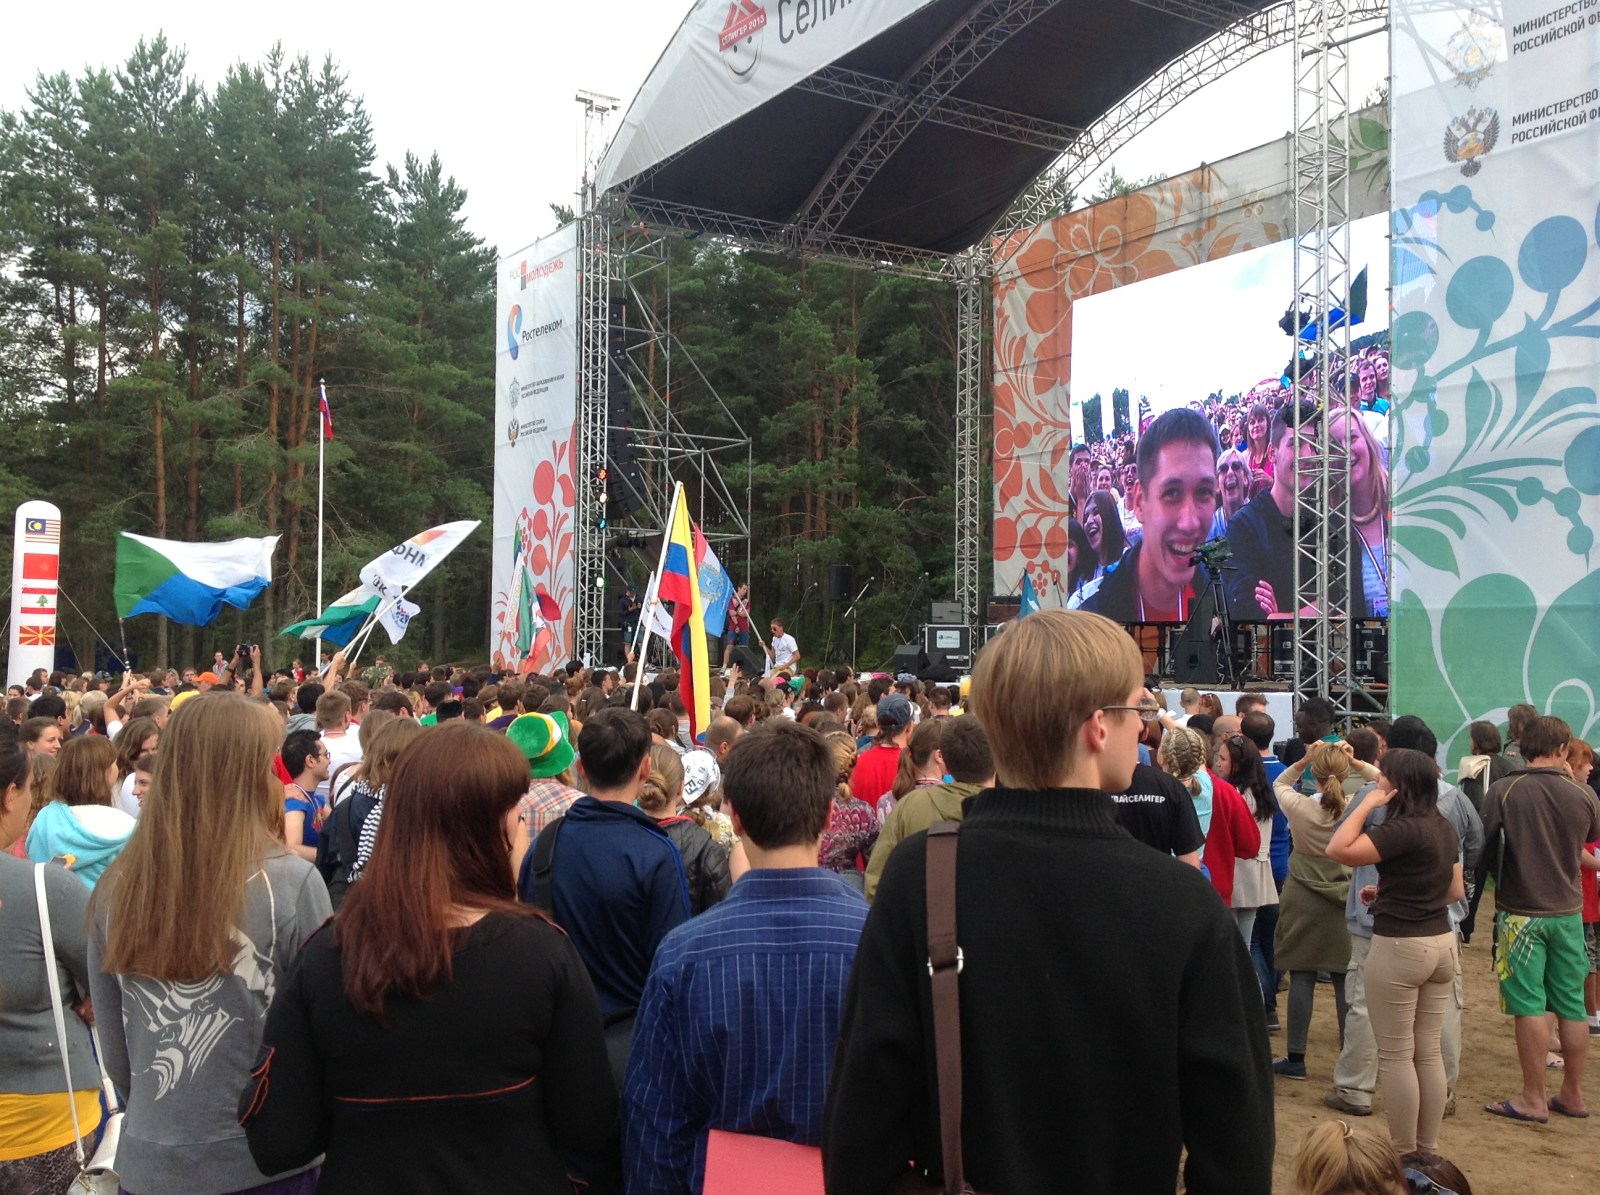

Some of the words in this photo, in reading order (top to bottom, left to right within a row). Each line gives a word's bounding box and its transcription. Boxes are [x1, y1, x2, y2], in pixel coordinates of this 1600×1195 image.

[721, 25, 748, 46] СЕЛИГЕР
[748, 14, 765, 32] 2013
[1513, 15, 1585, 55] РОССИЙСКОЙ
[1512, 88, 1599, 127] МИНИСТЕРСТВО
[1511, 110, 1587, 144] РОССИЙСКОЙ
[522, 318, 563, 344] Ростелеком
